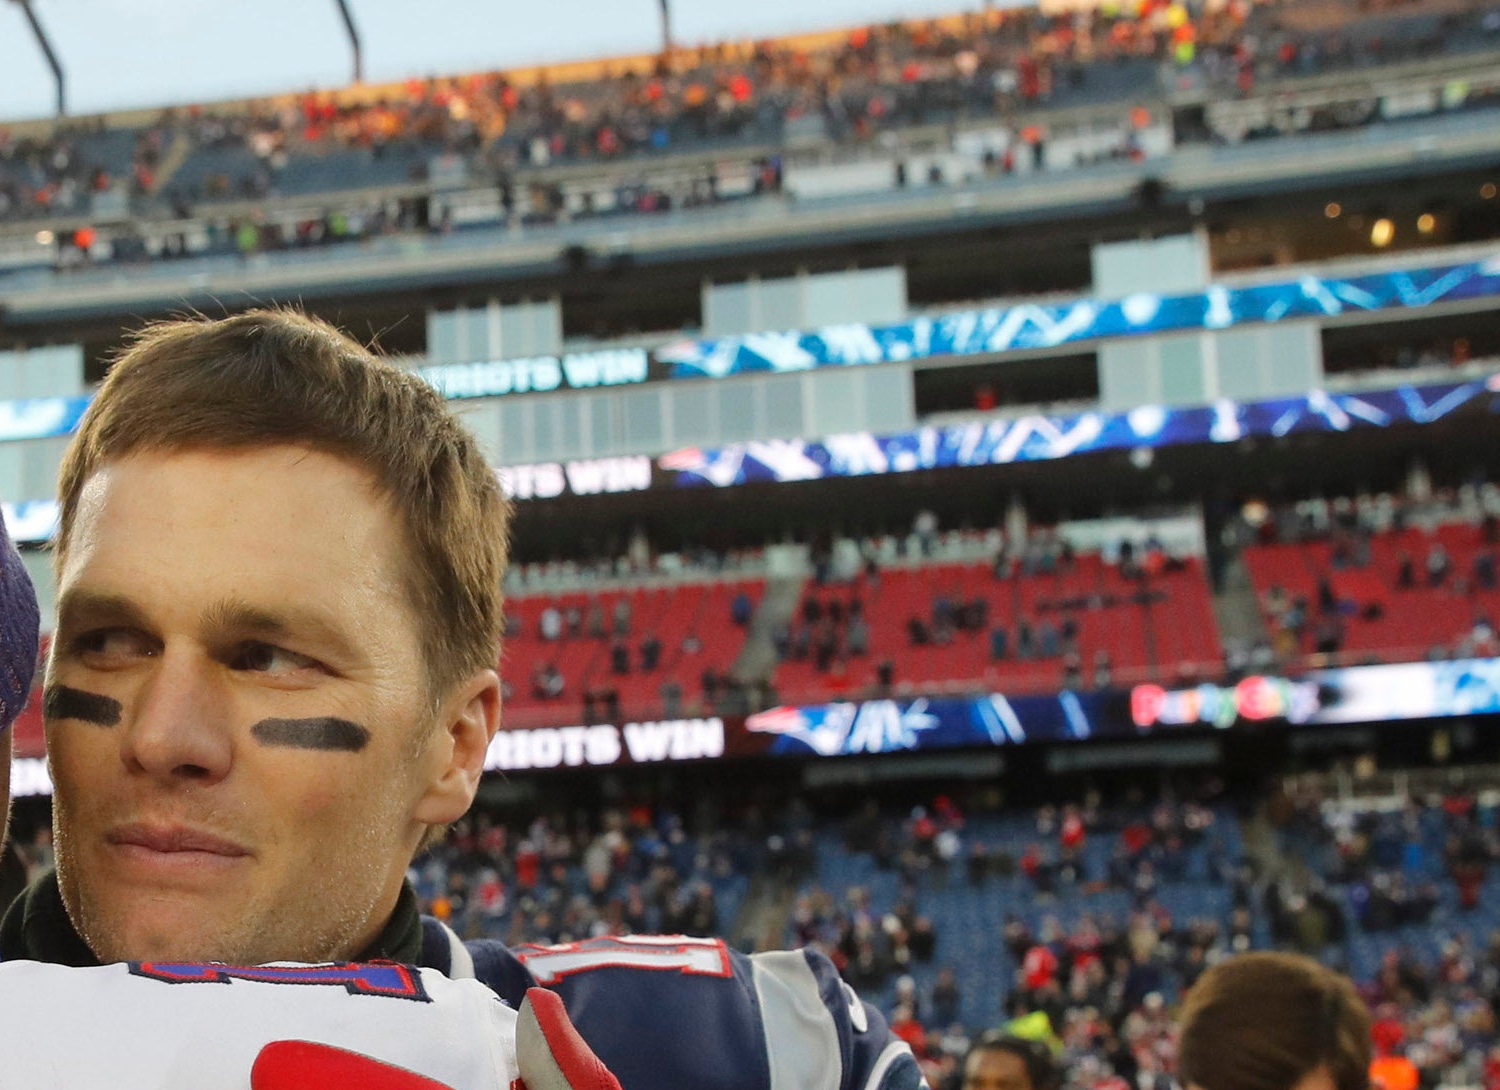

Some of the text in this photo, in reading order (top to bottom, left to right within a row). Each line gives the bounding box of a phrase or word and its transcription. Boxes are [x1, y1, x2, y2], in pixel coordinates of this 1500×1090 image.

[563, 348, 648, 389] WIN
[566, 455, 651, 496] WIN
[623, 717, 725, 763] WIN
